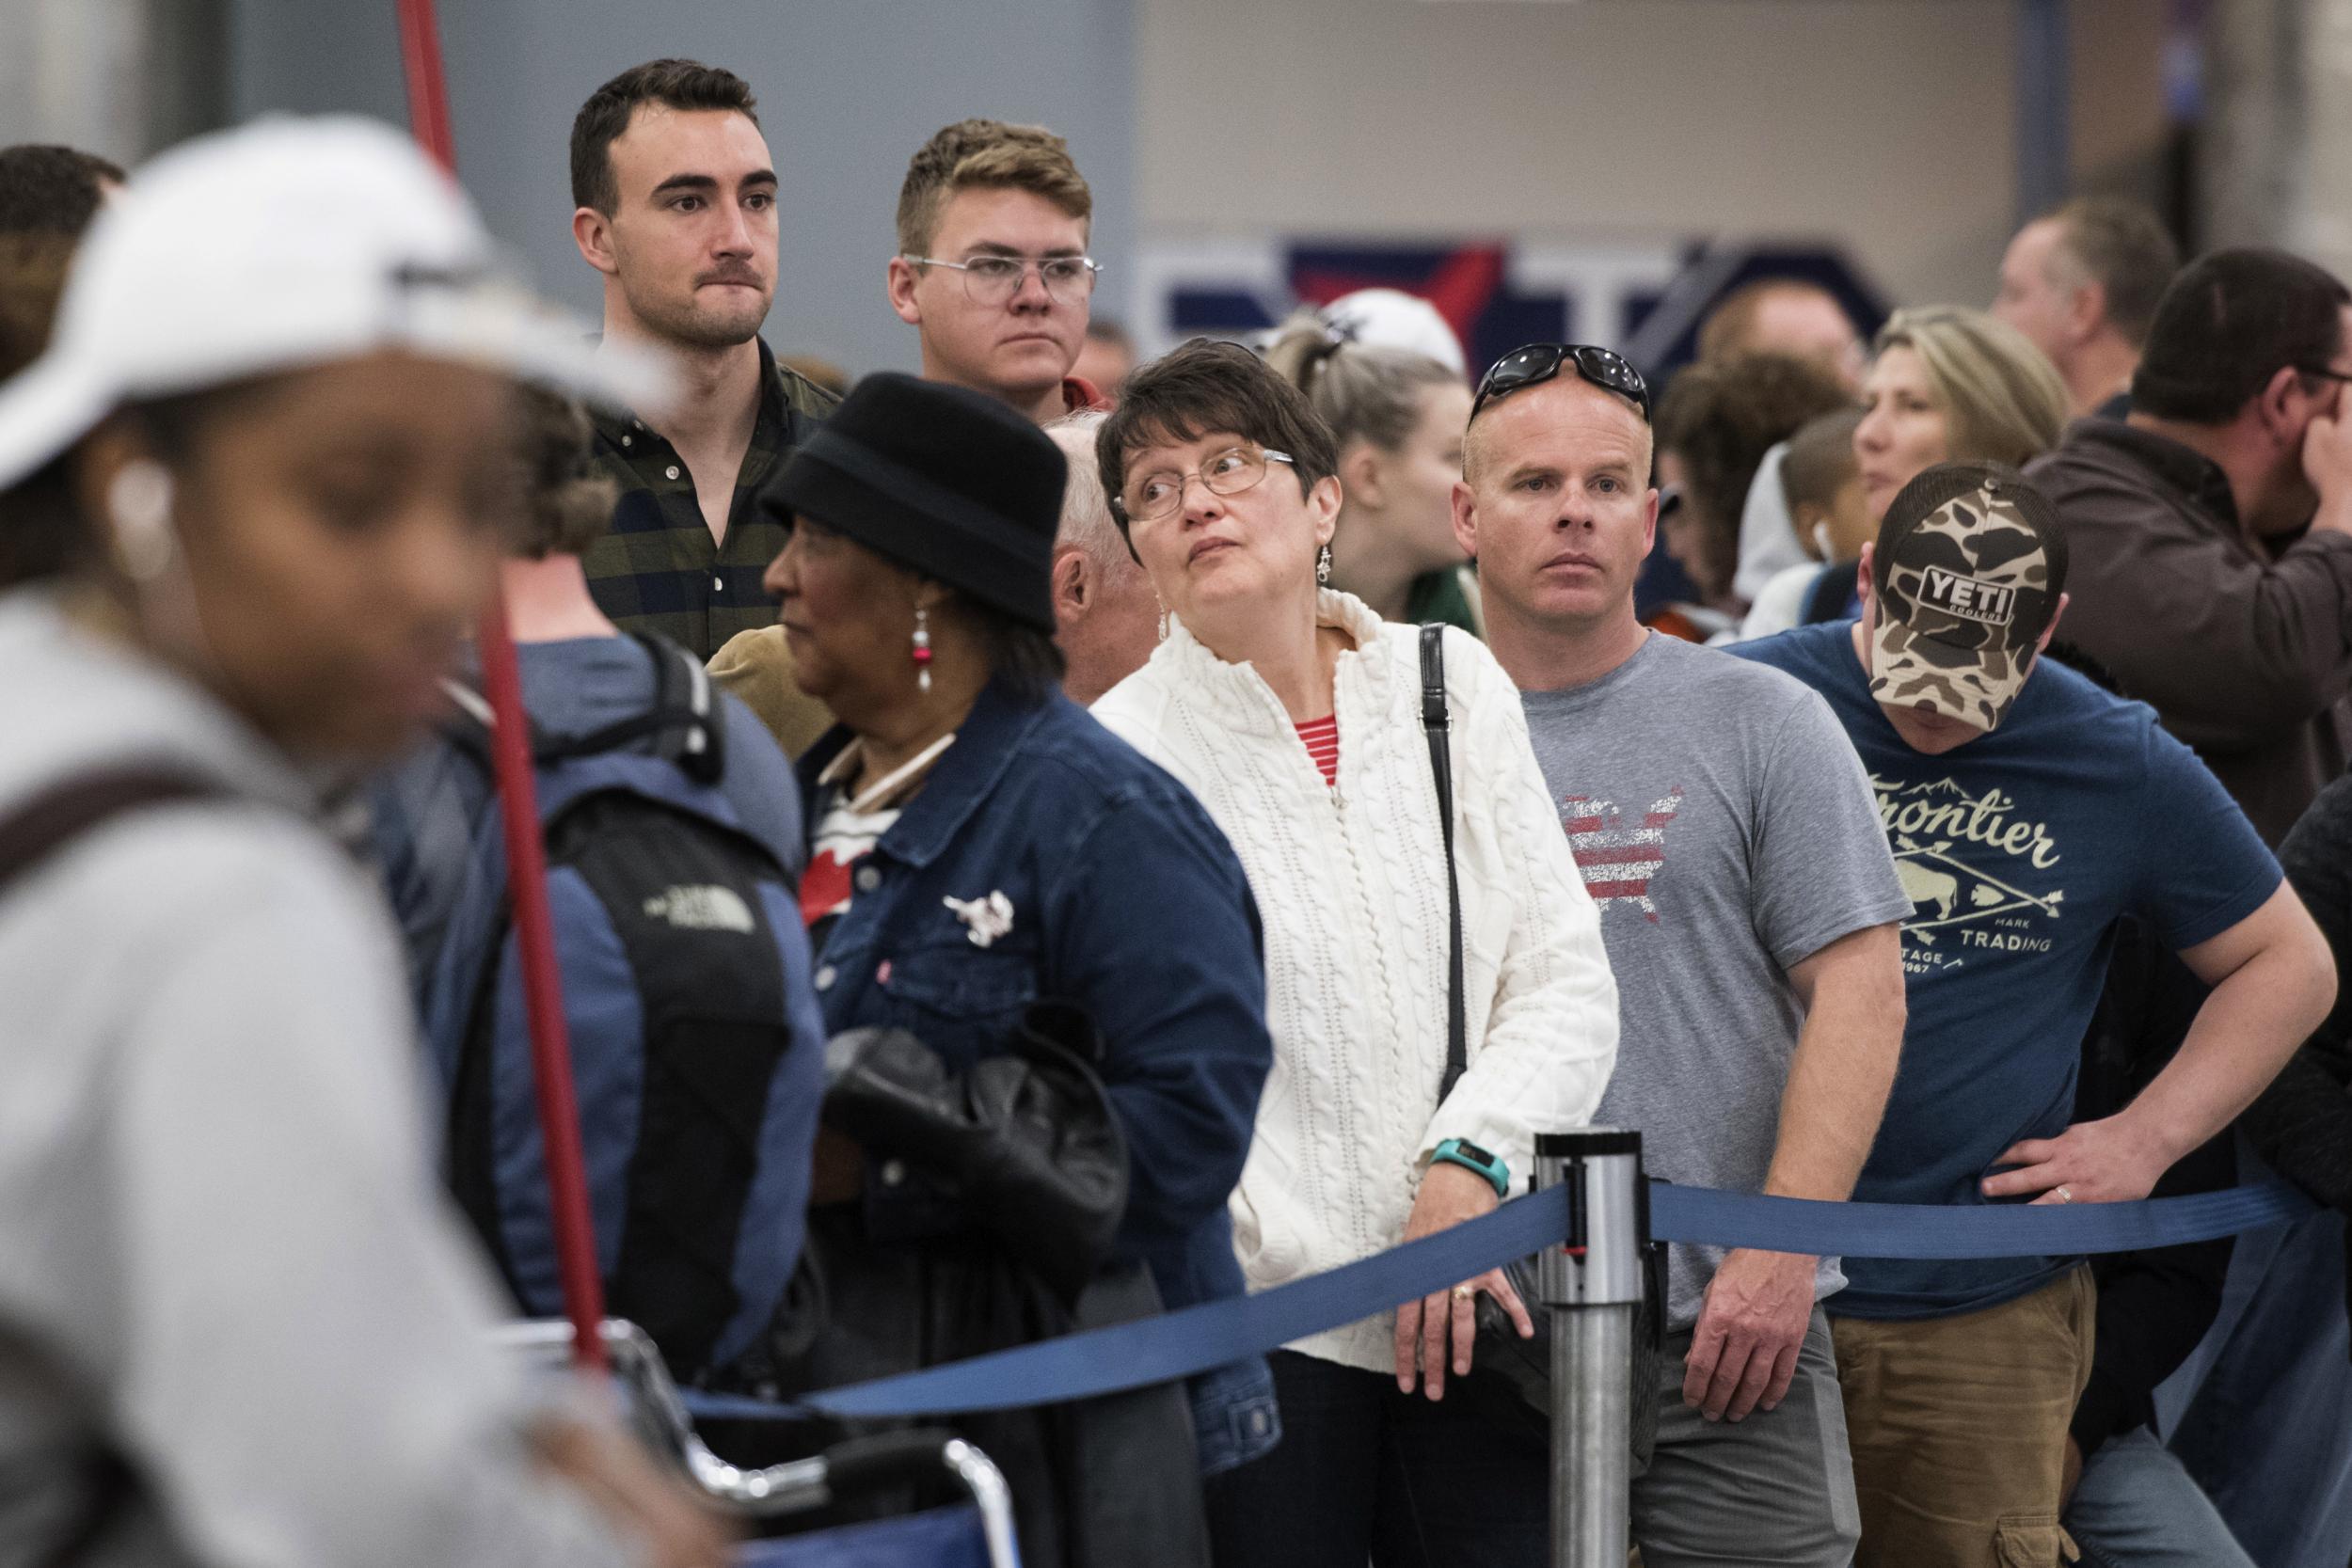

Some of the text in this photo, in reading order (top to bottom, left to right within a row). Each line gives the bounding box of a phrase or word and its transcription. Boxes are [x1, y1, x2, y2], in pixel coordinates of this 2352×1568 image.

[1931, 570, 2009, 614] YETI
[1949, 604, 2002, 622] COOLERS
[1994, 917, 2031, 929] MARK
[1960, 929, 2052, 953] TRADING
[1900, 947, 1943, 964] TAGE
